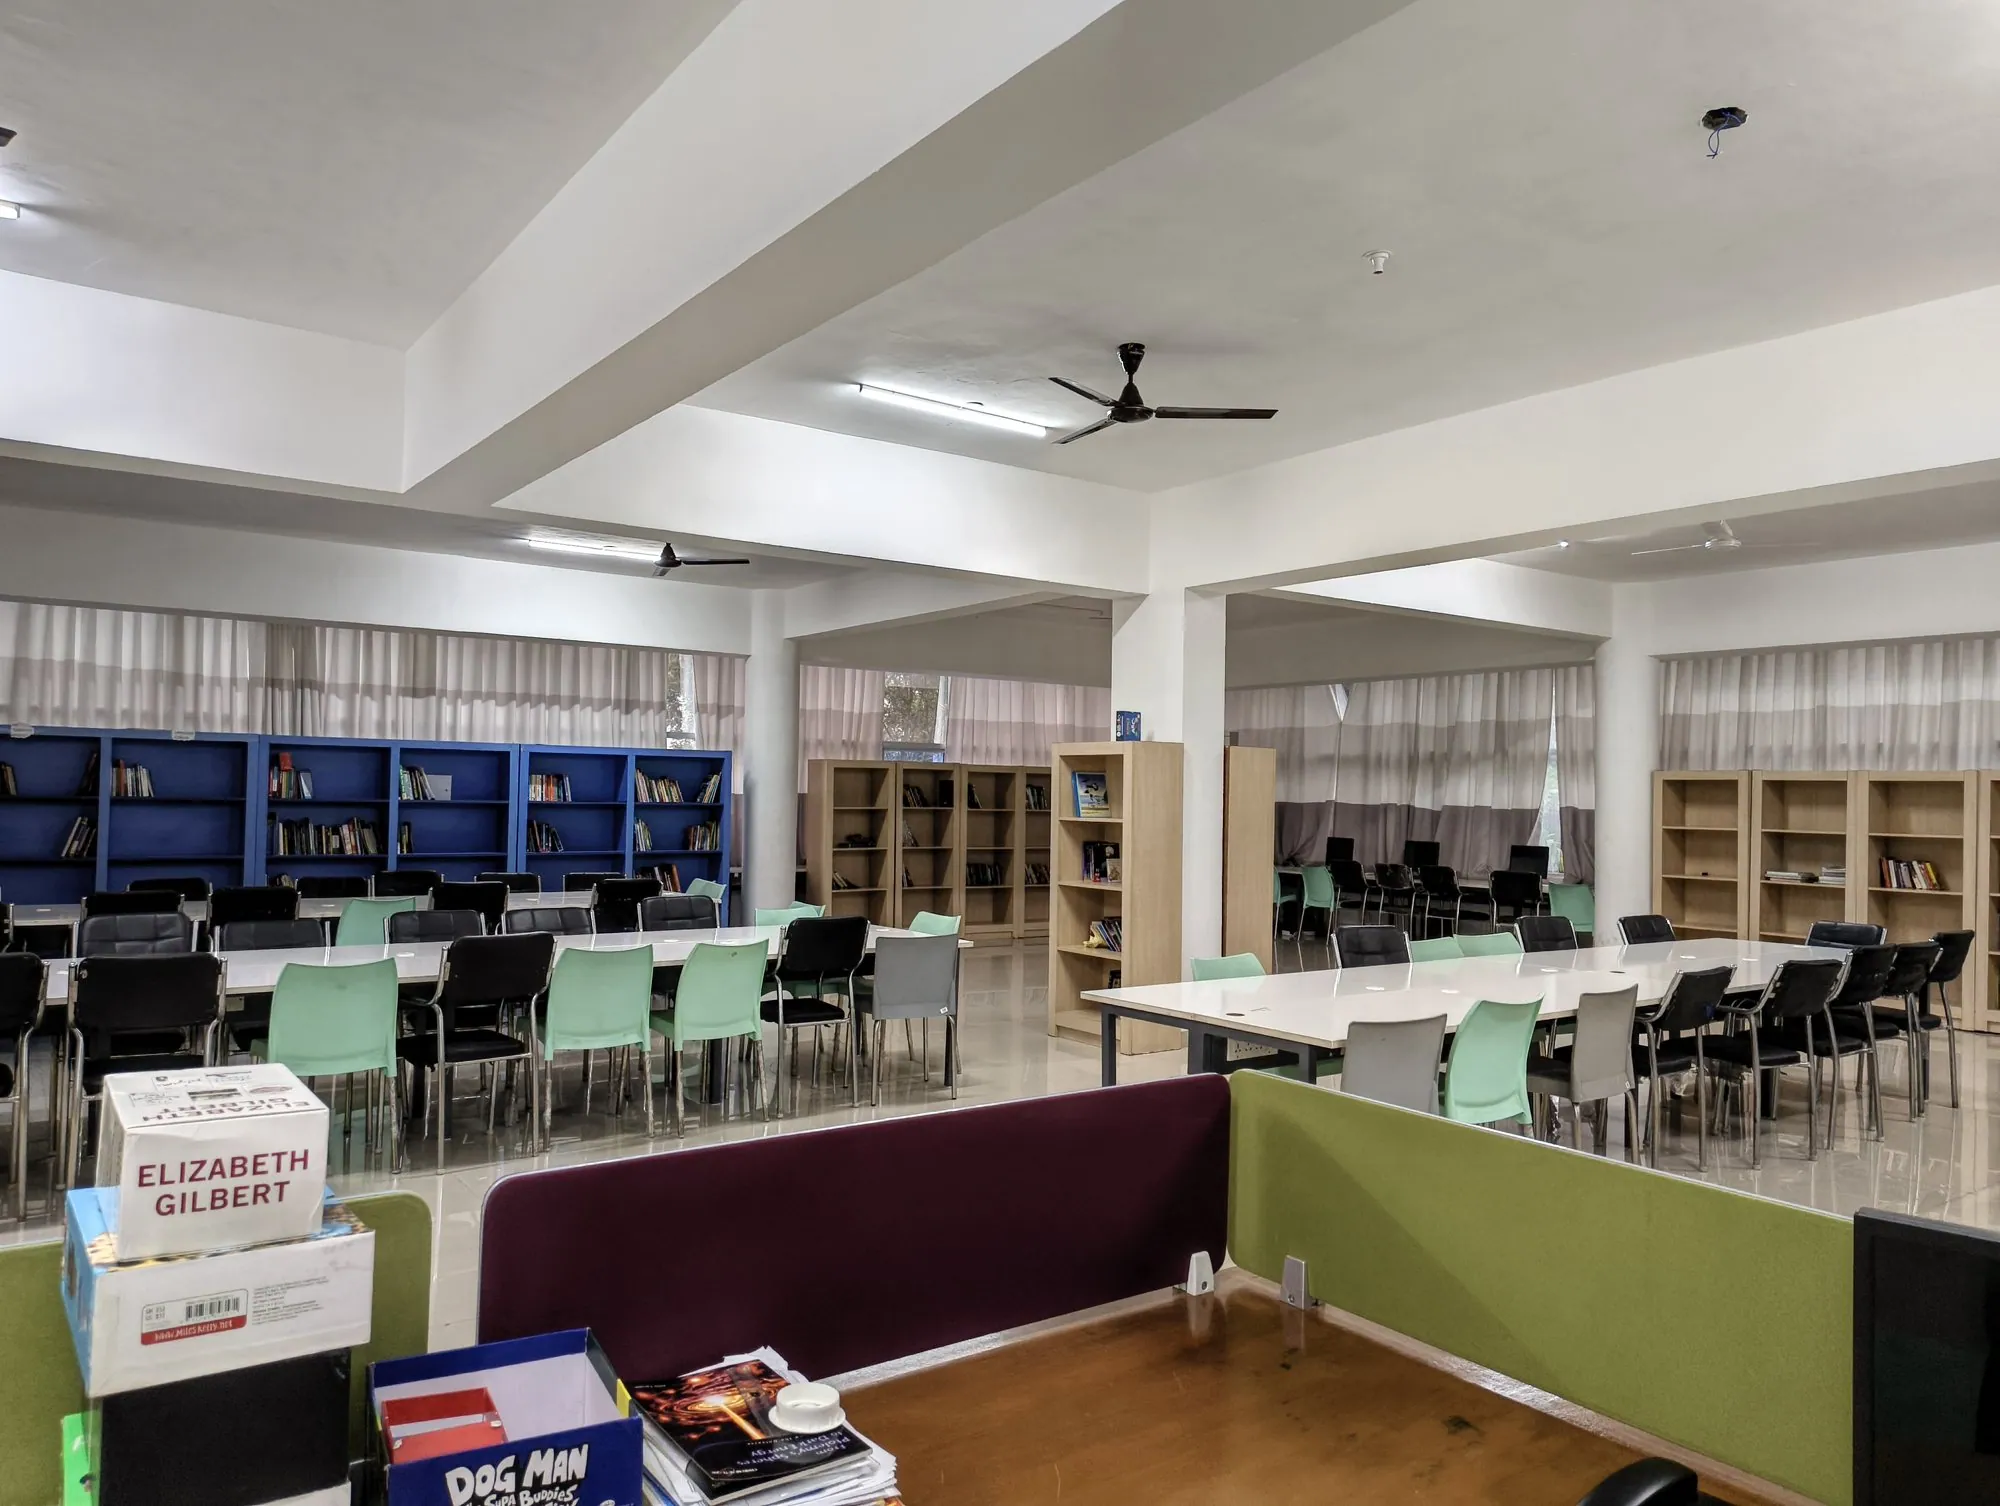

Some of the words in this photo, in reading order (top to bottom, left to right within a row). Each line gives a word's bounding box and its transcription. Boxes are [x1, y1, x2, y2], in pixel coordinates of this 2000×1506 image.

[142, 1101, 310, 1122] ELIZABETH
[137, 1148, 310, 1188] ELIZABETH
[155, 1180, 291, 1217] GILBERT
[445, 1454, 516, 1506] DOG
[522, 1443, 589, 1488] MAN
